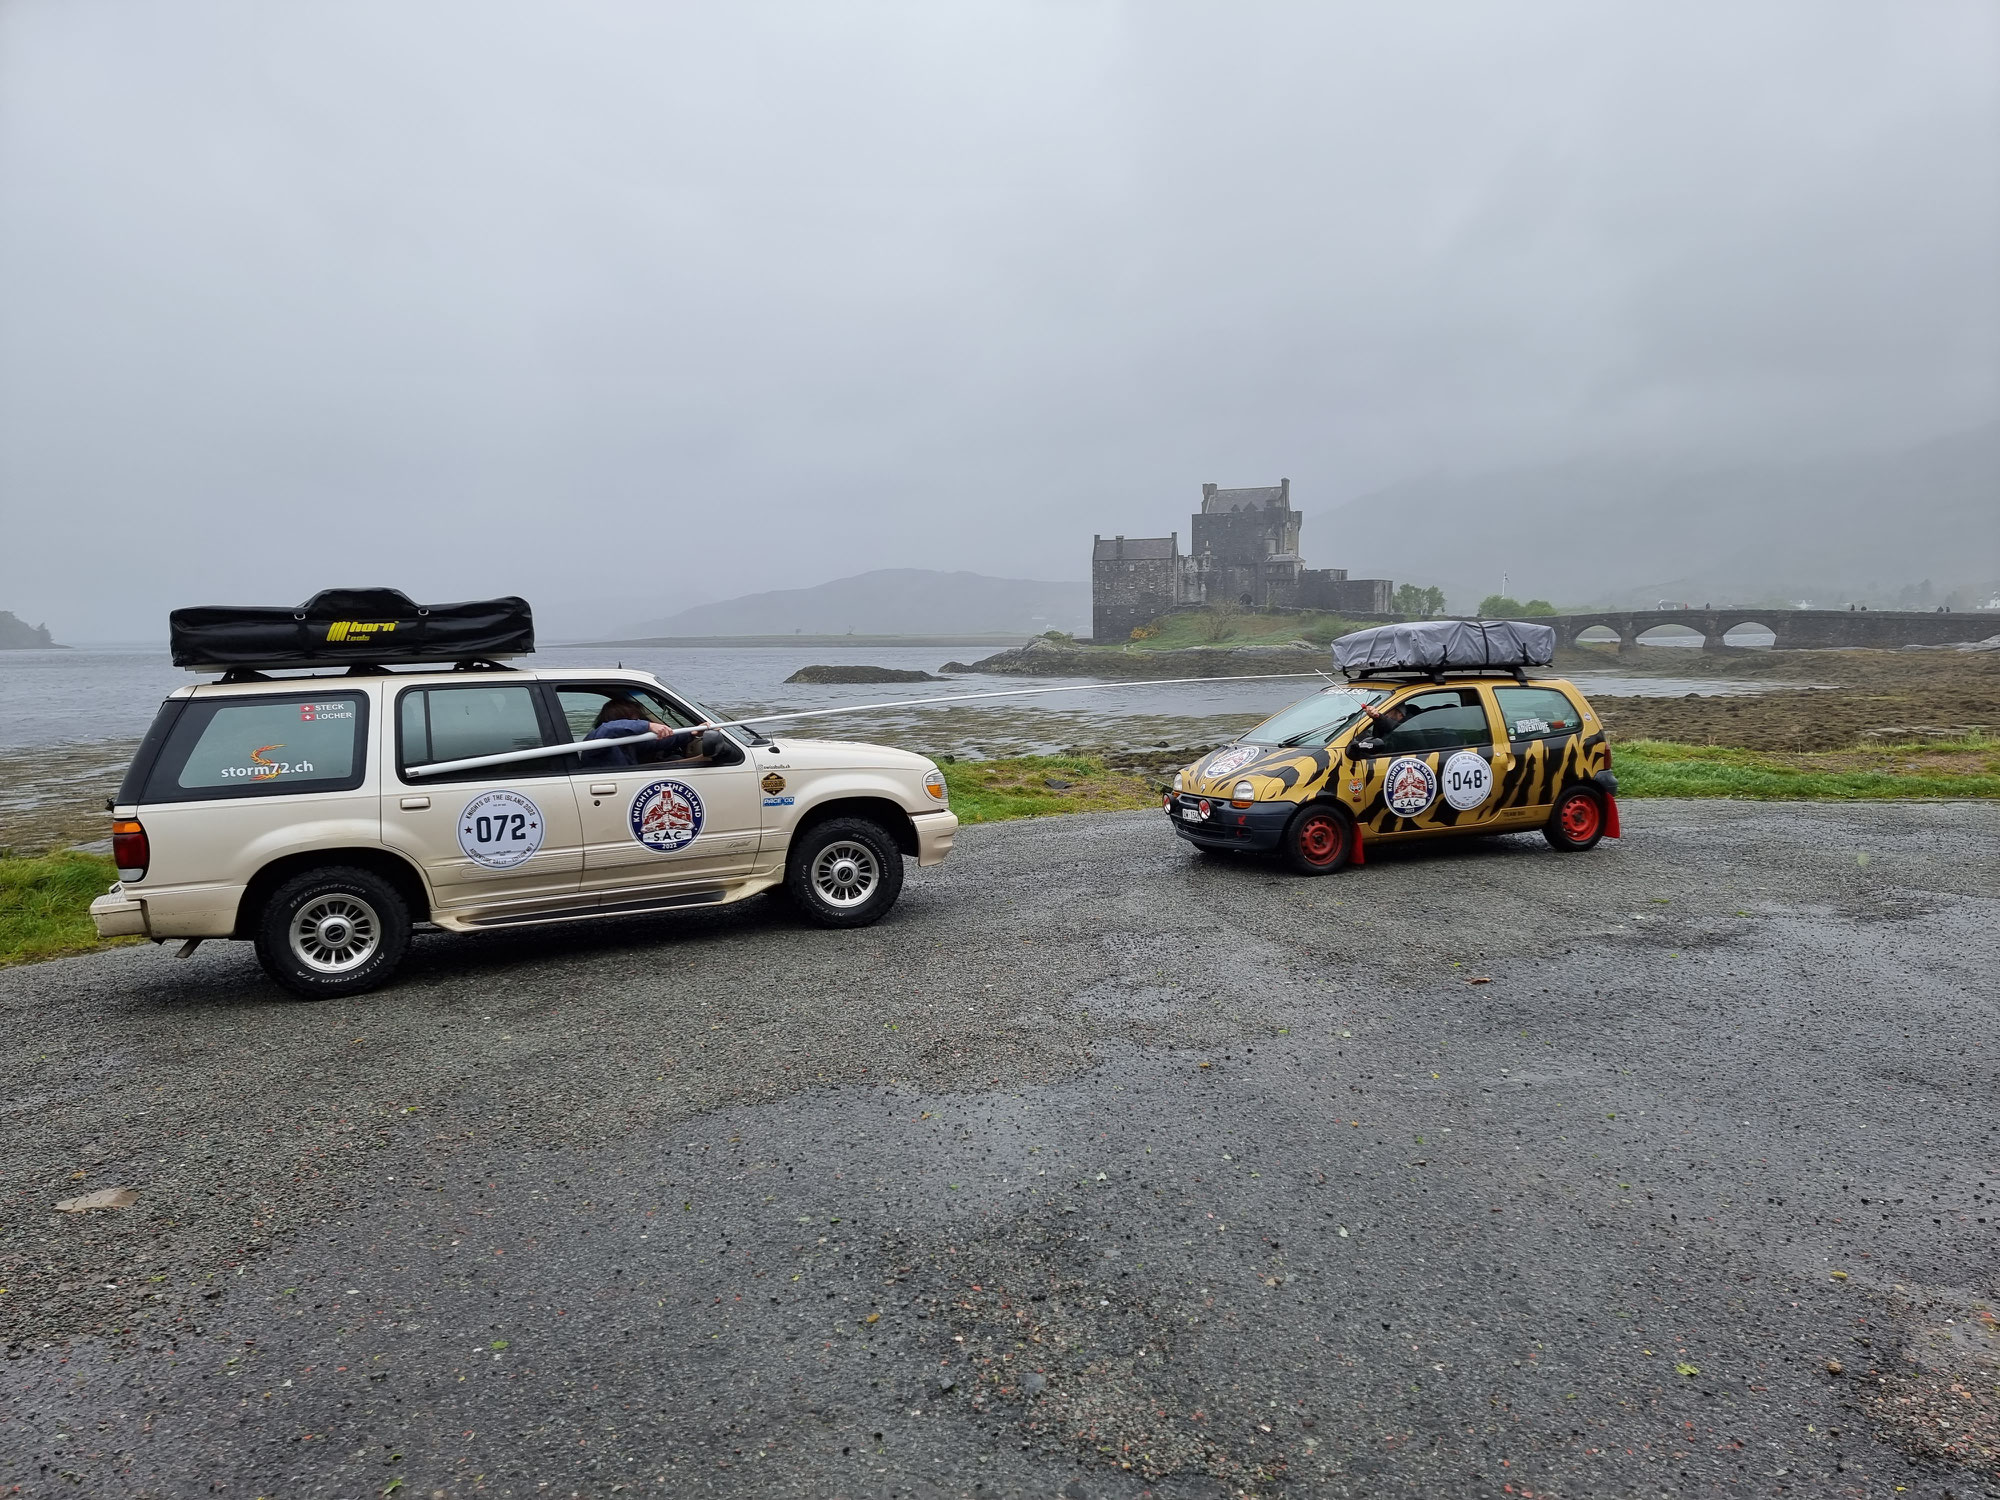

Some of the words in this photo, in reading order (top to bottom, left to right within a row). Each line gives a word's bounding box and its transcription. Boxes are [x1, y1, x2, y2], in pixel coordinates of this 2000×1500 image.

[350, 621, 396, 632] horn
[221, 761, 314, 778] storm72.ch
[1388, 766, 1400, 792] KNIGHTS
[1421, 767, 1434, 790] ISLAND
[1452, 770, 1482, 791] 048
[466, 800, 484, 820] KNIGHTS
[504, 794, 524, 806] ISLAND
[524, 803, 536, 816] 2022
[634, 789, 653, 822] KNIGHTS
[654, 784, 665, 792] OF
[667, 782, 684, 792] THE
[684, 789, 702, 818] ISLAND
[476, 814, 526, 842] 072
[297, 970, 315, 981] T/A
